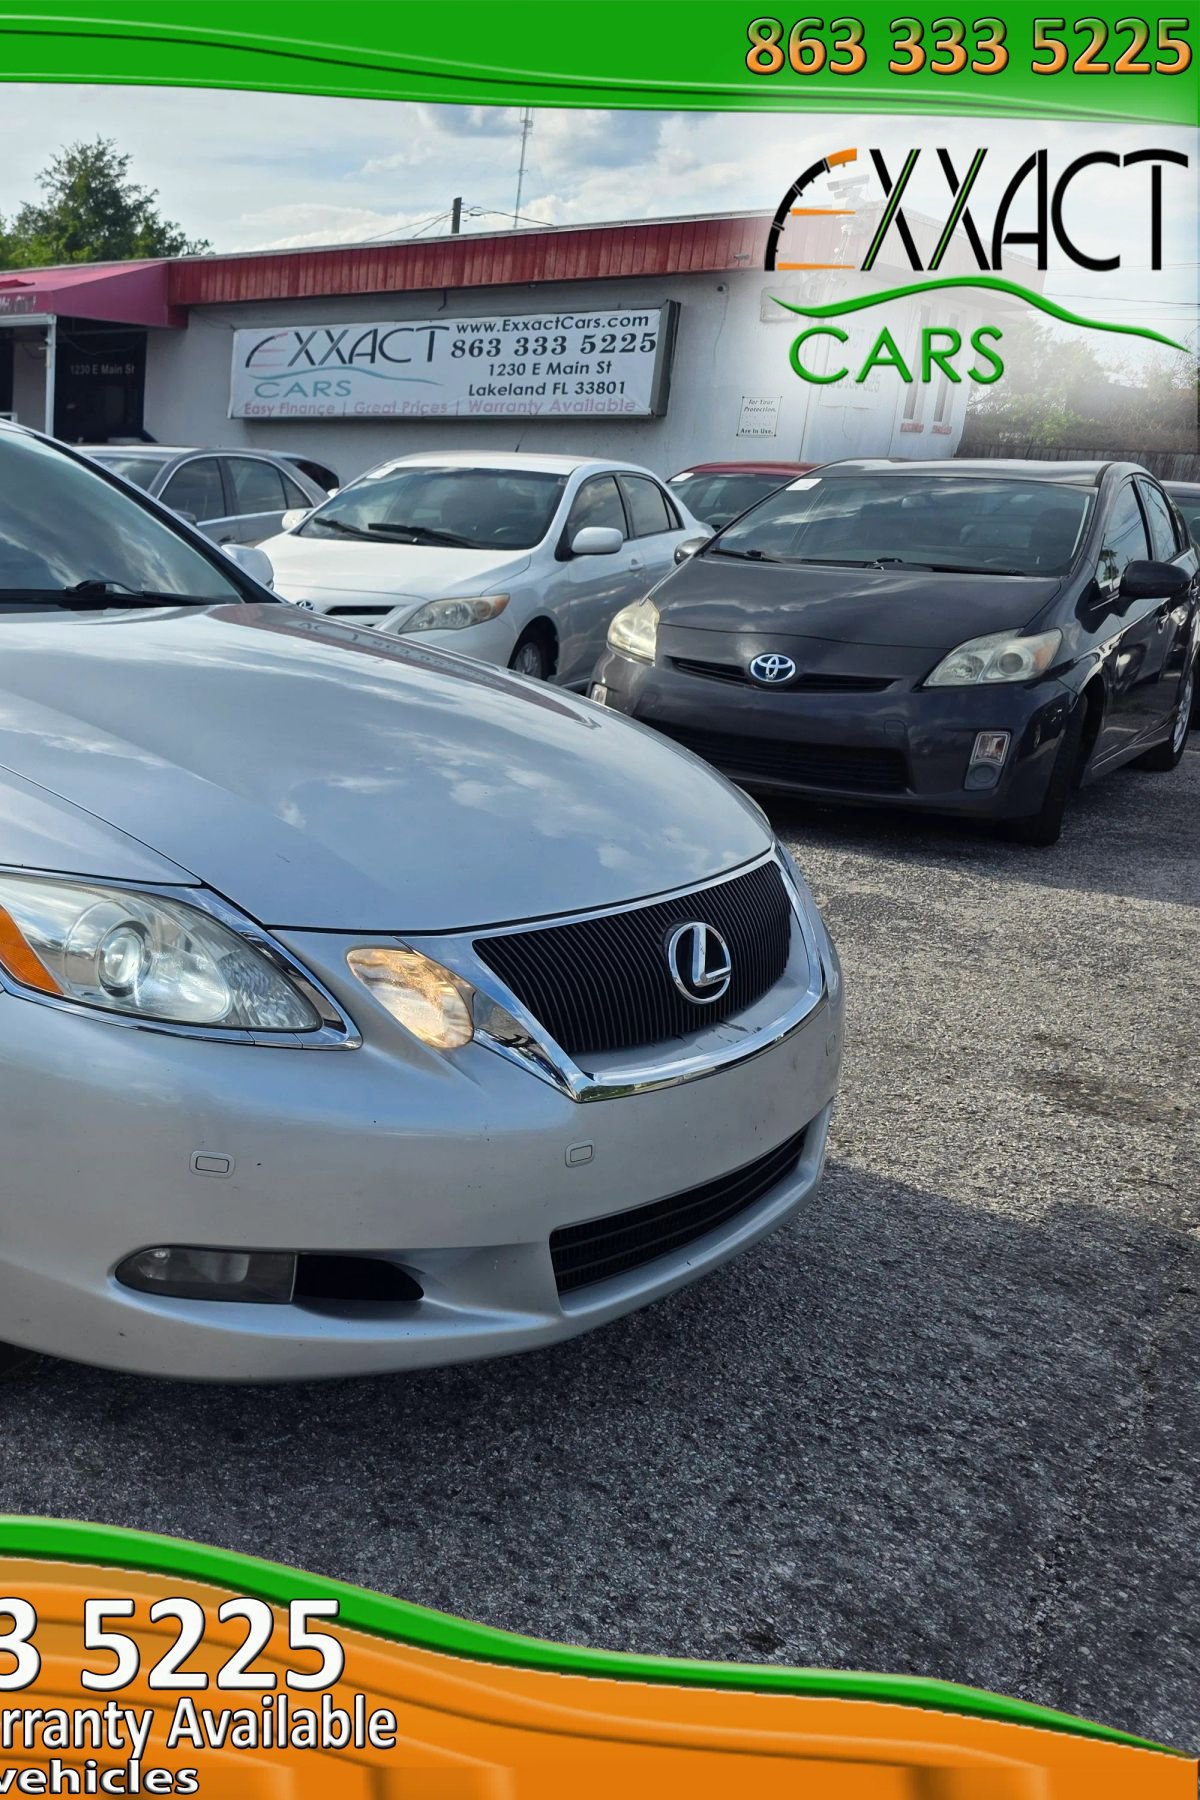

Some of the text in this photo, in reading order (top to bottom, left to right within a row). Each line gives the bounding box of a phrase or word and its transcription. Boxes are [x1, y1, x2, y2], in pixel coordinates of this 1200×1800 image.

[456, 314, 649, 335] www.ExxactCars.com
[245, 326, 450, 369] EXXACT
[451, 332, 657, 358] 863 333 5225
[101, 363, 123, 375] Main
[488, 360, 612, 376] 1230 E Main St
[254, 380, 352, 399] CARS
[468, 381, 626, 397] Lakeland FL 33801
[243, 398, 636, 417] Easy Finance Great Prices Warranty Available
